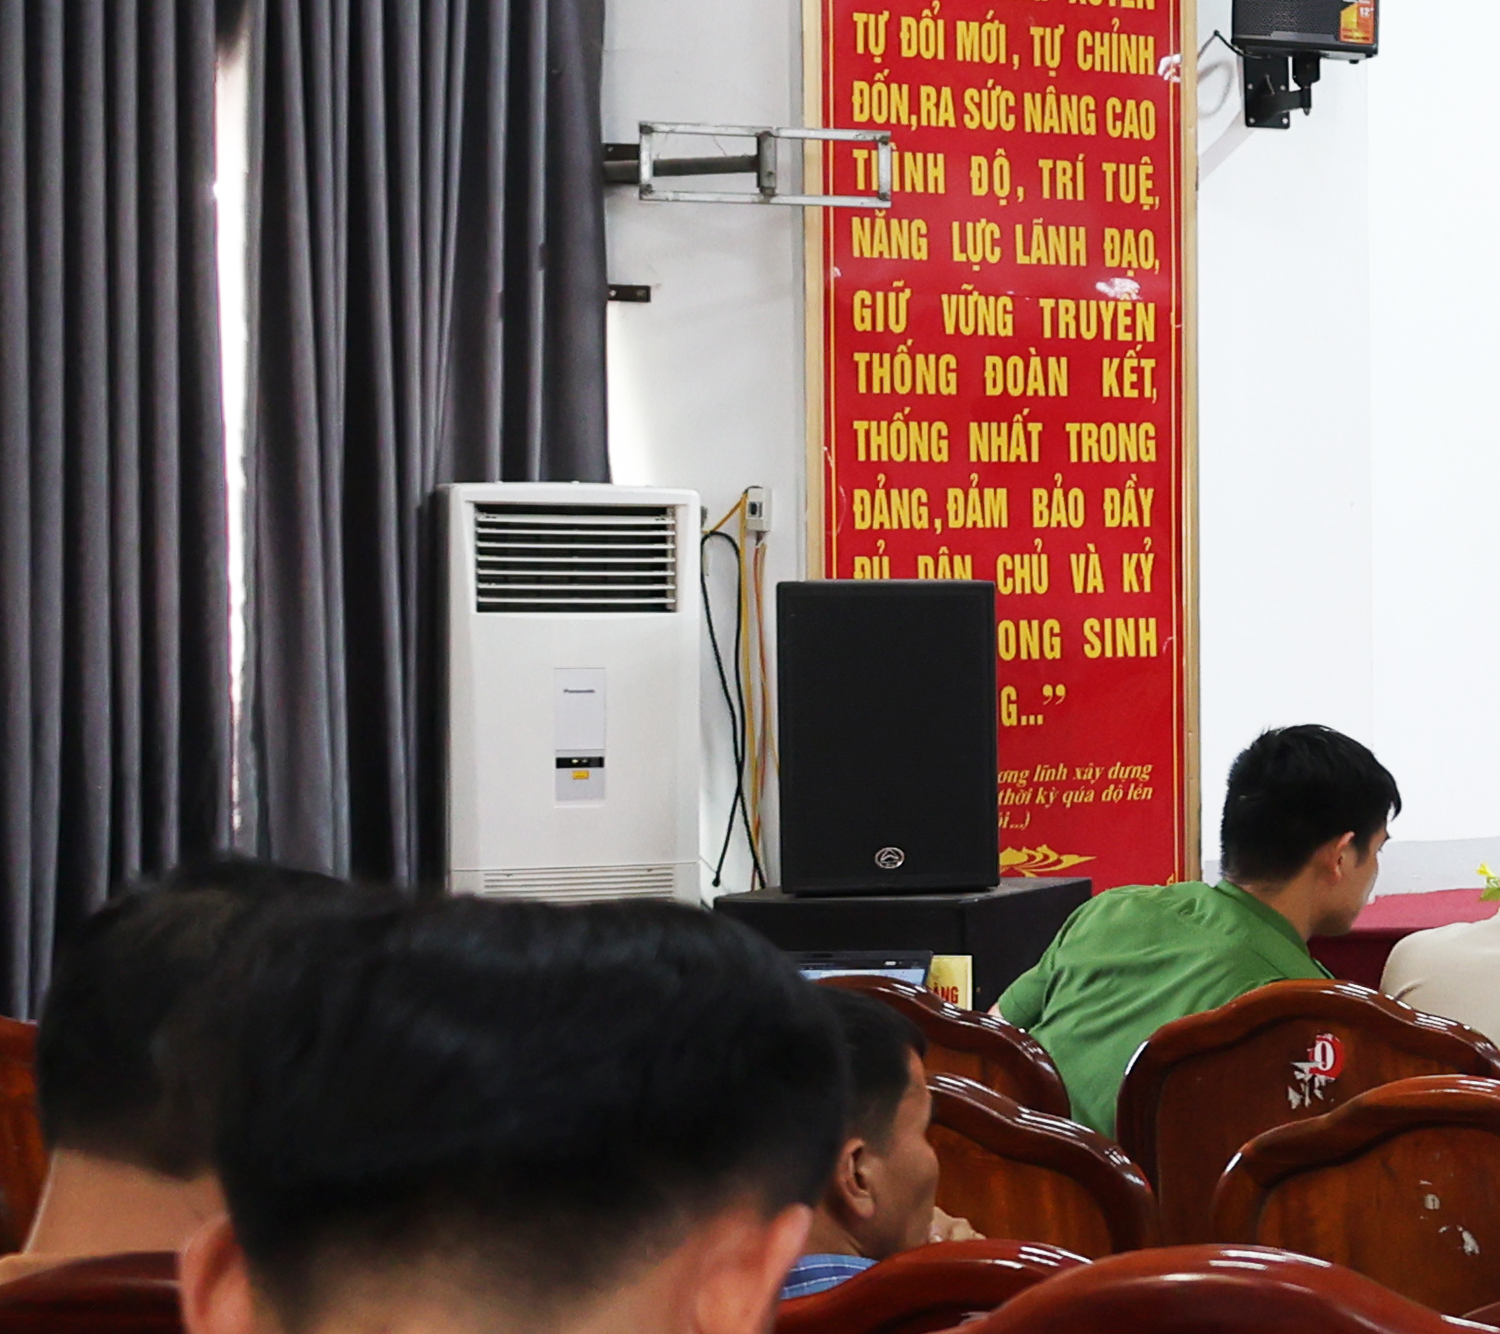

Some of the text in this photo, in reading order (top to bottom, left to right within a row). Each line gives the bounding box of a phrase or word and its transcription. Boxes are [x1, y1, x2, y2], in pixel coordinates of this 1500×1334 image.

[852, 210, 1159, 276] NĂNG LỰC LÃNH ĐẠO,
[854, 345, 1156, 400] THỐNG ĐOÀN KẾT,
[854, 408, 1156, 462] THỐNG NHẤT TRONG
[997, 537, 1154, 594] CHỦ VÀ KỶ
[1084, 618, 1156, 658] SINH
[998, 762, 1153, 787] ơng lĩnh xây dựng
[1035, 787, 1057, 808] kỳ
[1102, 785, 1123, 803] độ
